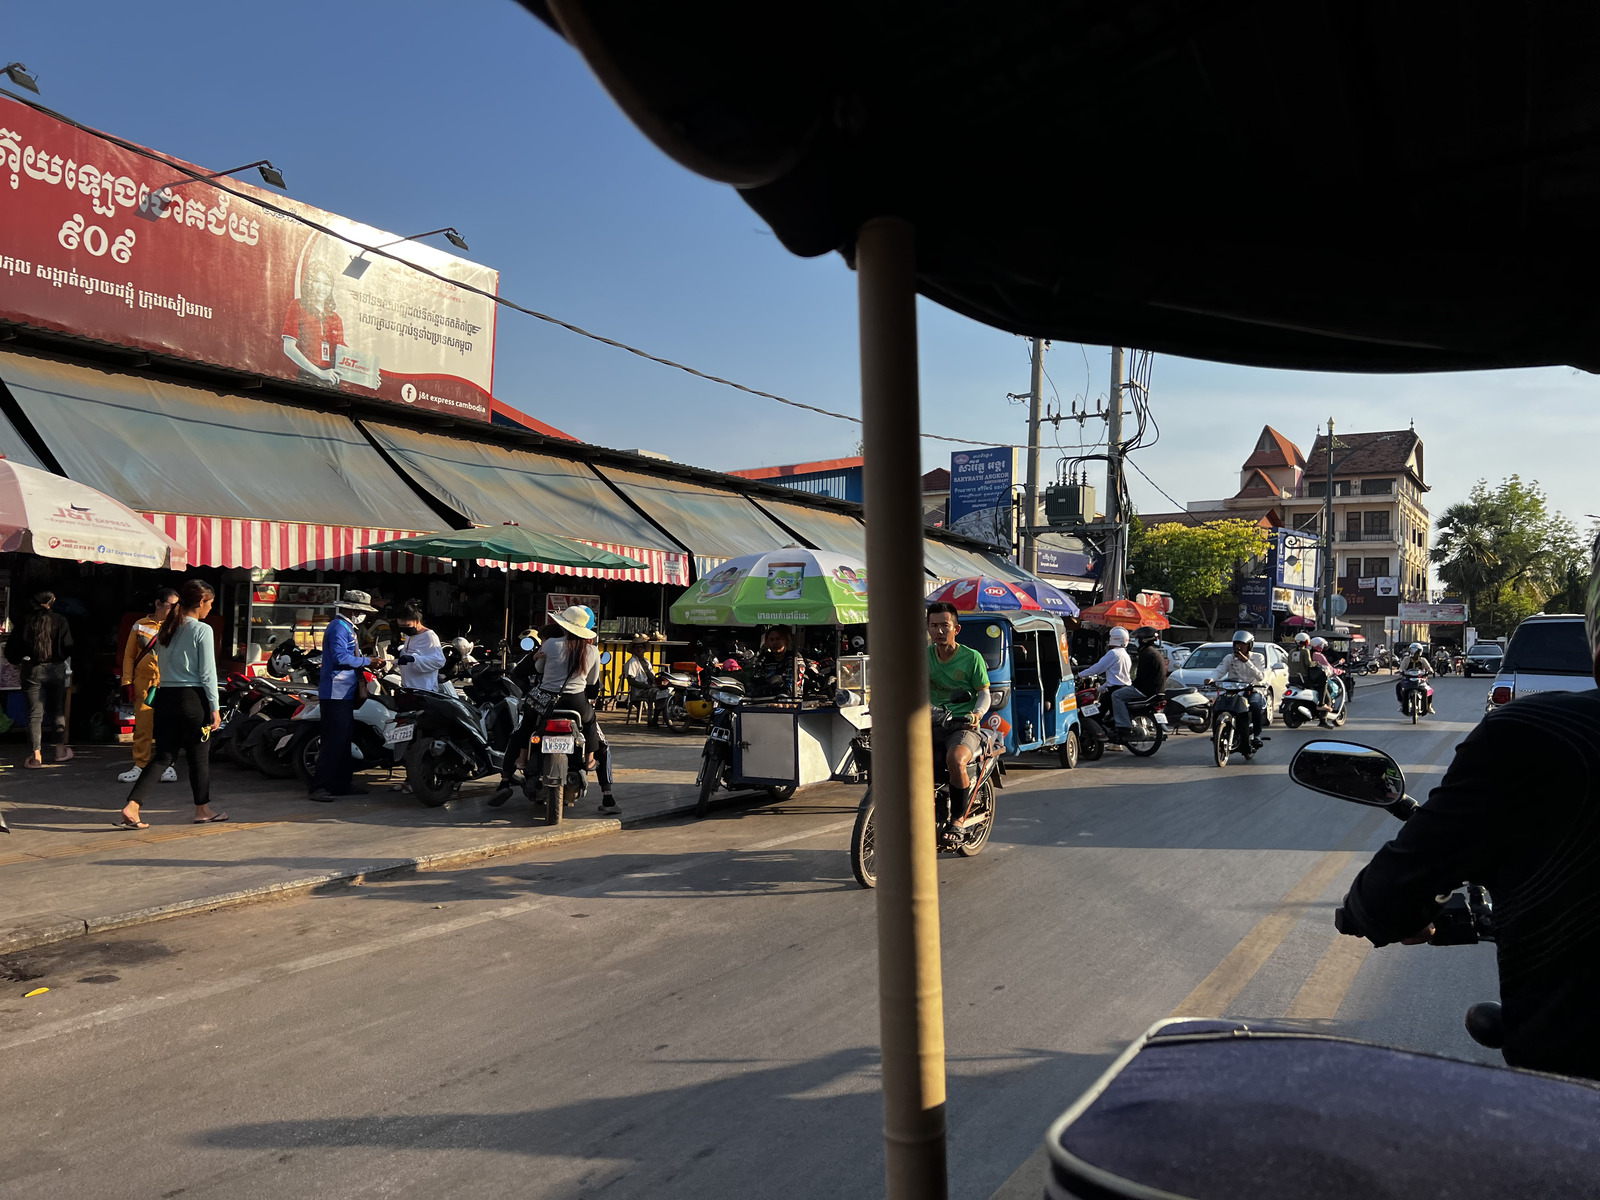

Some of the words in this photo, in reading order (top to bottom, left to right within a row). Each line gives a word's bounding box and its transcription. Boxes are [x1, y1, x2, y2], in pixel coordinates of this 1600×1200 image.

[58, 213, 136, 264] ៩០៩
[138, 290, 213, 320] ក្រុងសៀមរាប
[339, 357, 358, 368] J&T
[418, 390, 429, 401] j&t
[430, 394, 455, 407] express
[455, 396, 486, 413] cambodia
[984, 472, 1010, 480] ANGKOR
[988, 588, 1003, 596] DQ
